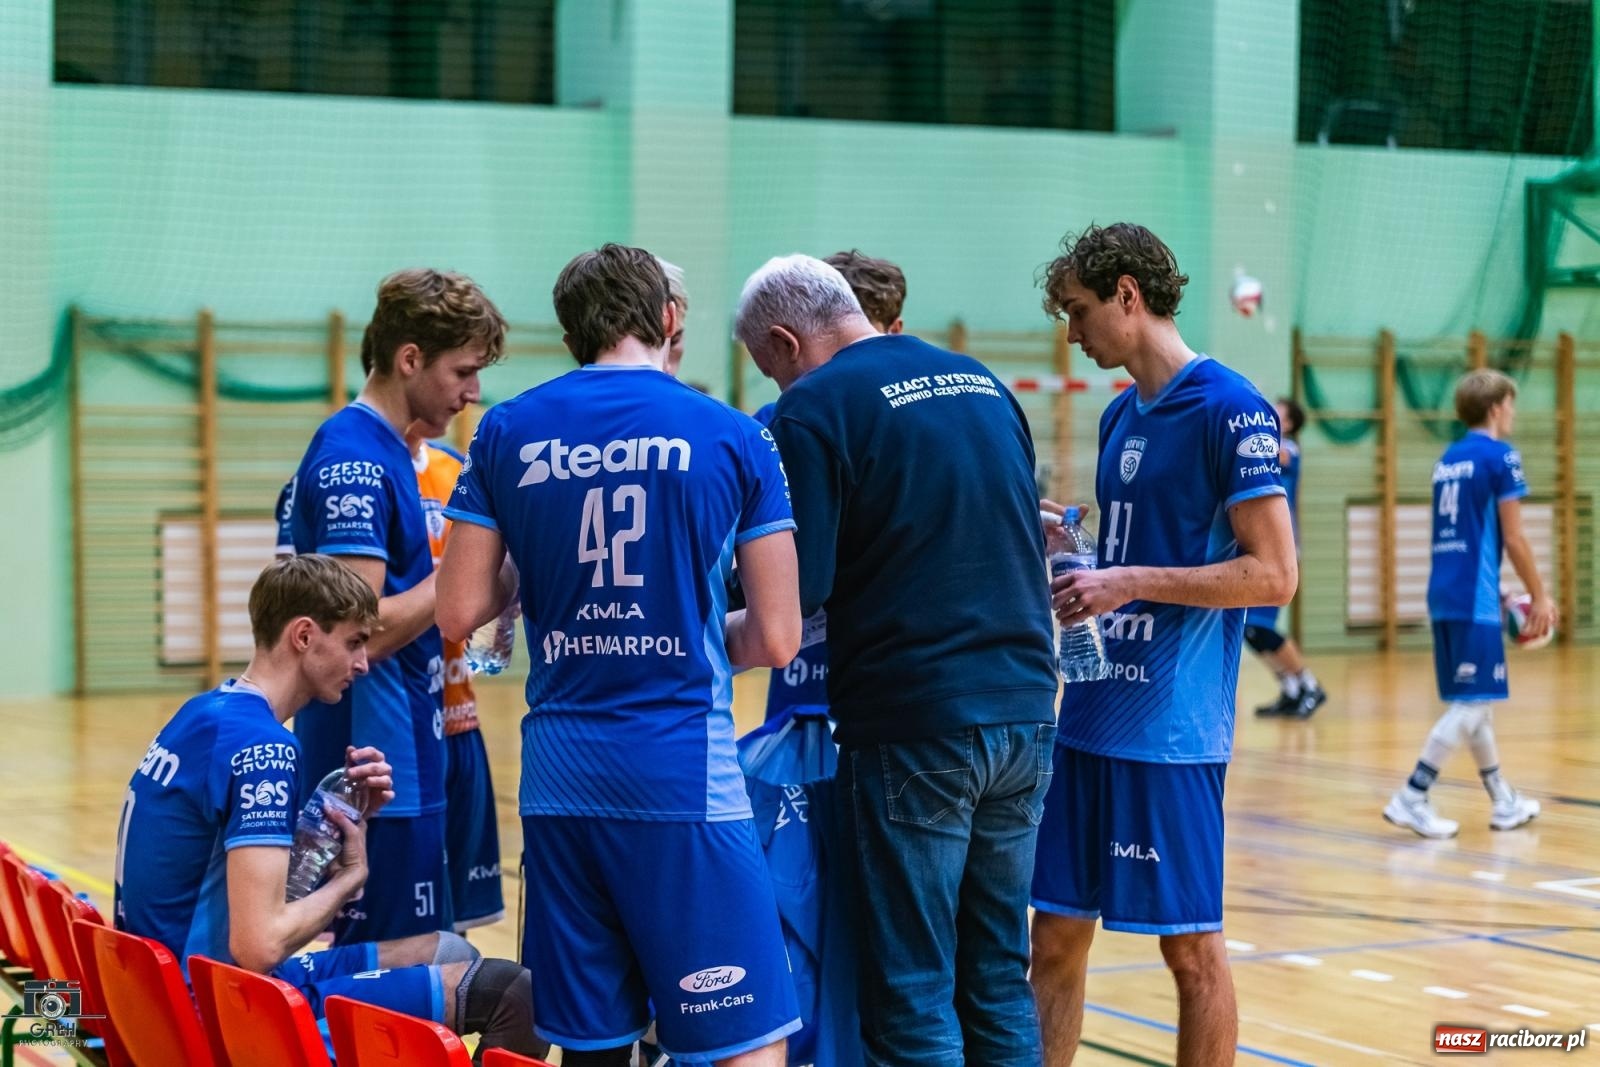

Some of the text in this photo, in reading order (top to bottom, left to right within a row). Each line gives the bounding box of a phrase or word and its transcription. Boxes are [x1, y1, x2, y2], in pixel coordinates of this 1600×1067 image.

[880, 373, 996, 399] EXACT SYSTEMS
[889, 384, 1002, 409] NORWID CZĘSTOCHOWA
[325, 493, 375, 519] SOS
[577, 484, 647, 588] 42
[1105, 500, 1133, 563] 41
[564, 635, 687, 657] HEMARPOL
[240, 779, 289, 810] SOS
[415, 882, 435, 918] 51
[693, 968, 733, 990] Ford
[680, 993, 754, 1015] Frank-Cars
